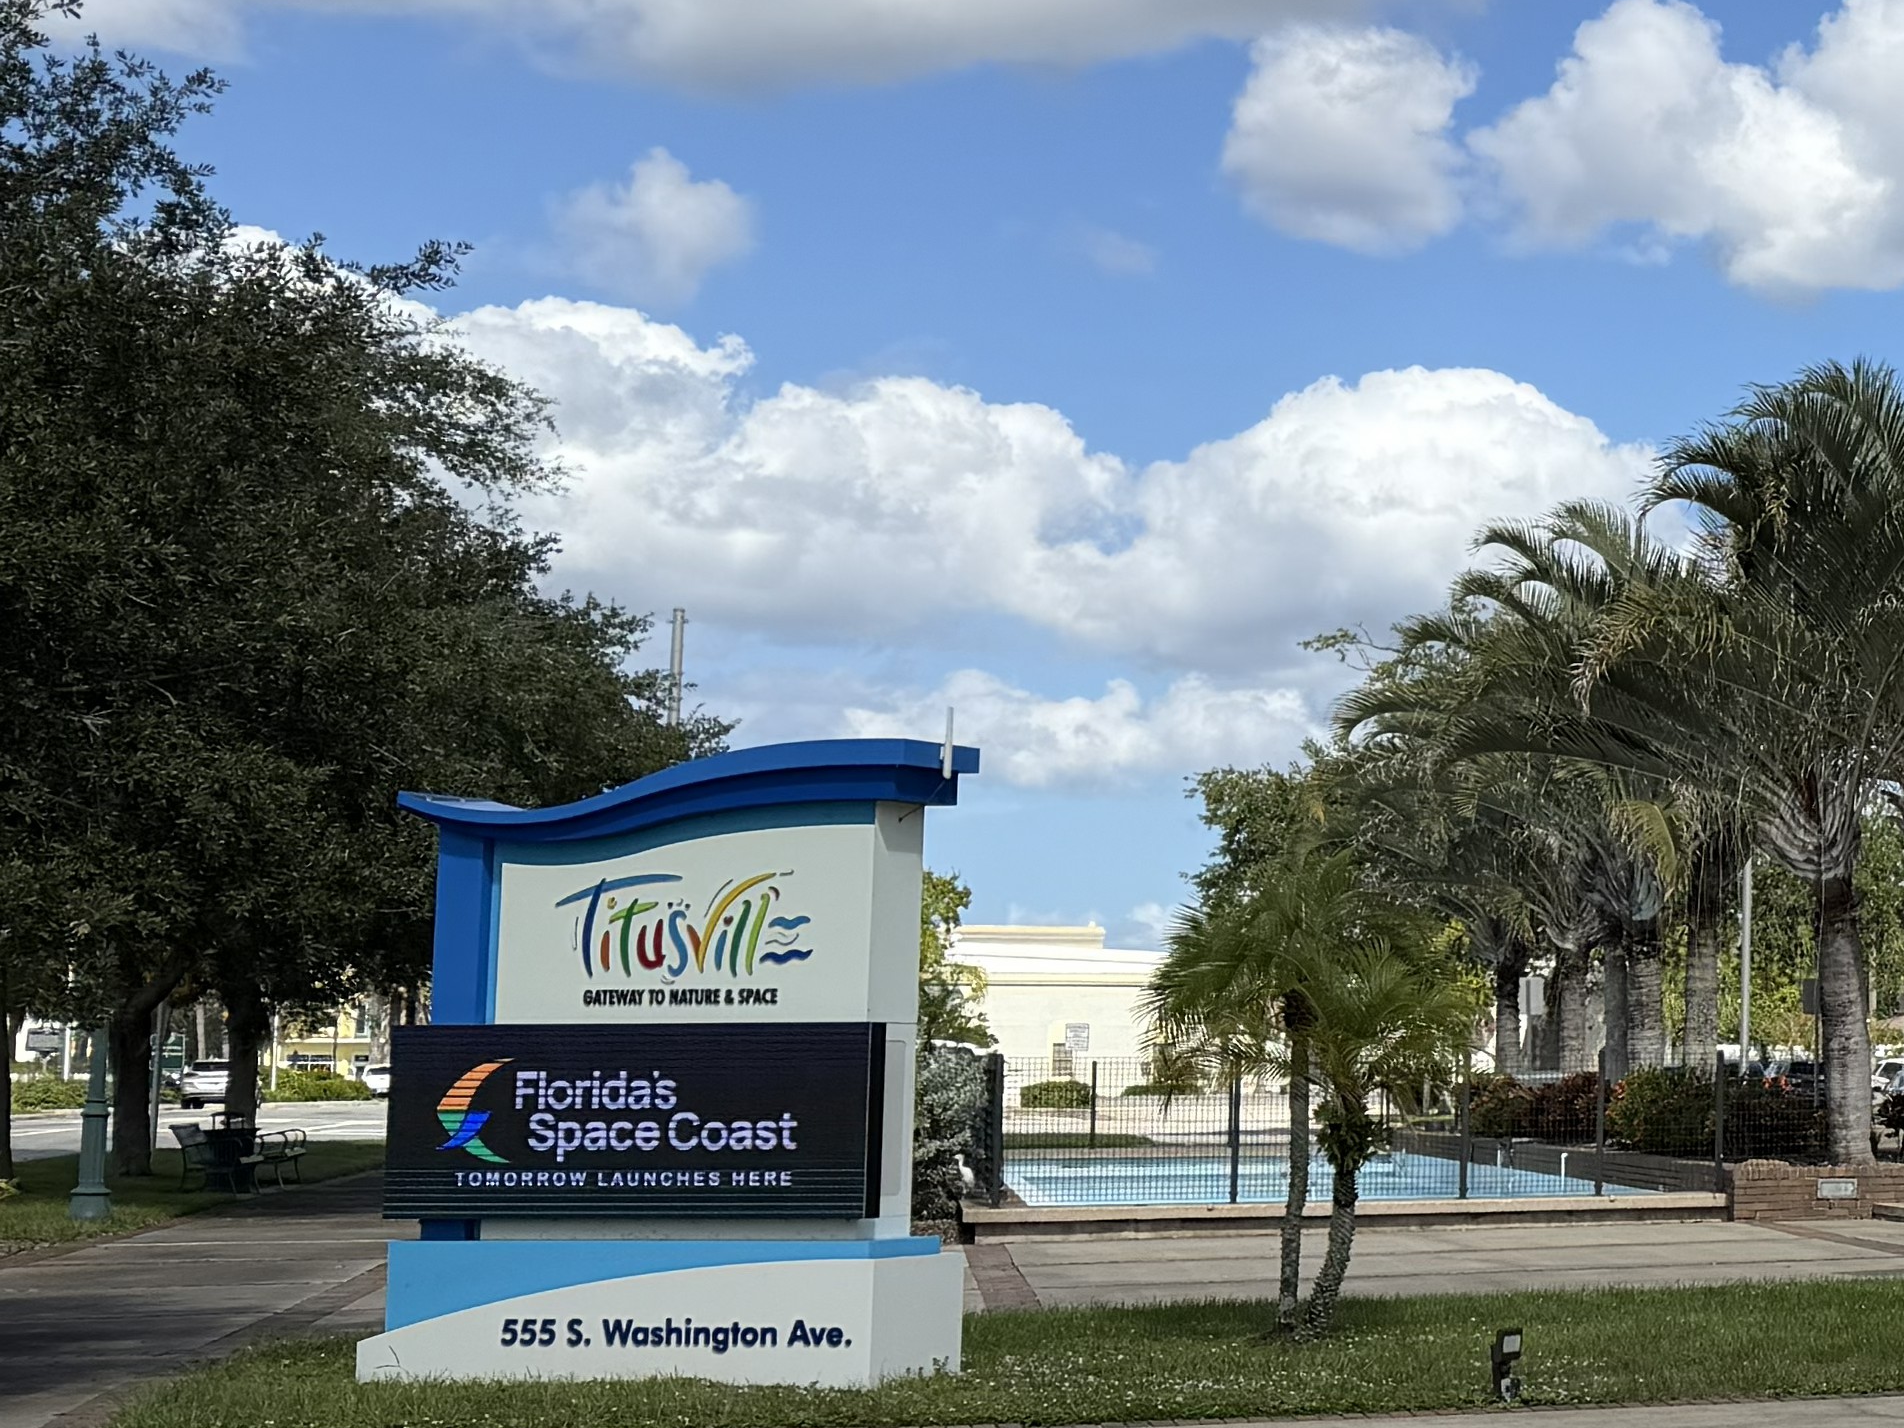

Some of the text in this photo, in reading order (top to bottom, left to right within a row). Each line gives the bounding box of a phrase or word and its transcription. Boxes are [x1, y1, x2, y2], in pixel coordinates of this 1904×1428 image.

[583, 988, 778, 1006] GATEWAY TO NATURE & SPACE
[515, 1071, 677, 1110] Florida's
[528, 1112, 798, 1162] Space Coast
[454, 1172, 794, 1187] TOMORROW LAUNCHES HERE
[500, 1318, 853, 1355] 555 S. Washington Ave.
